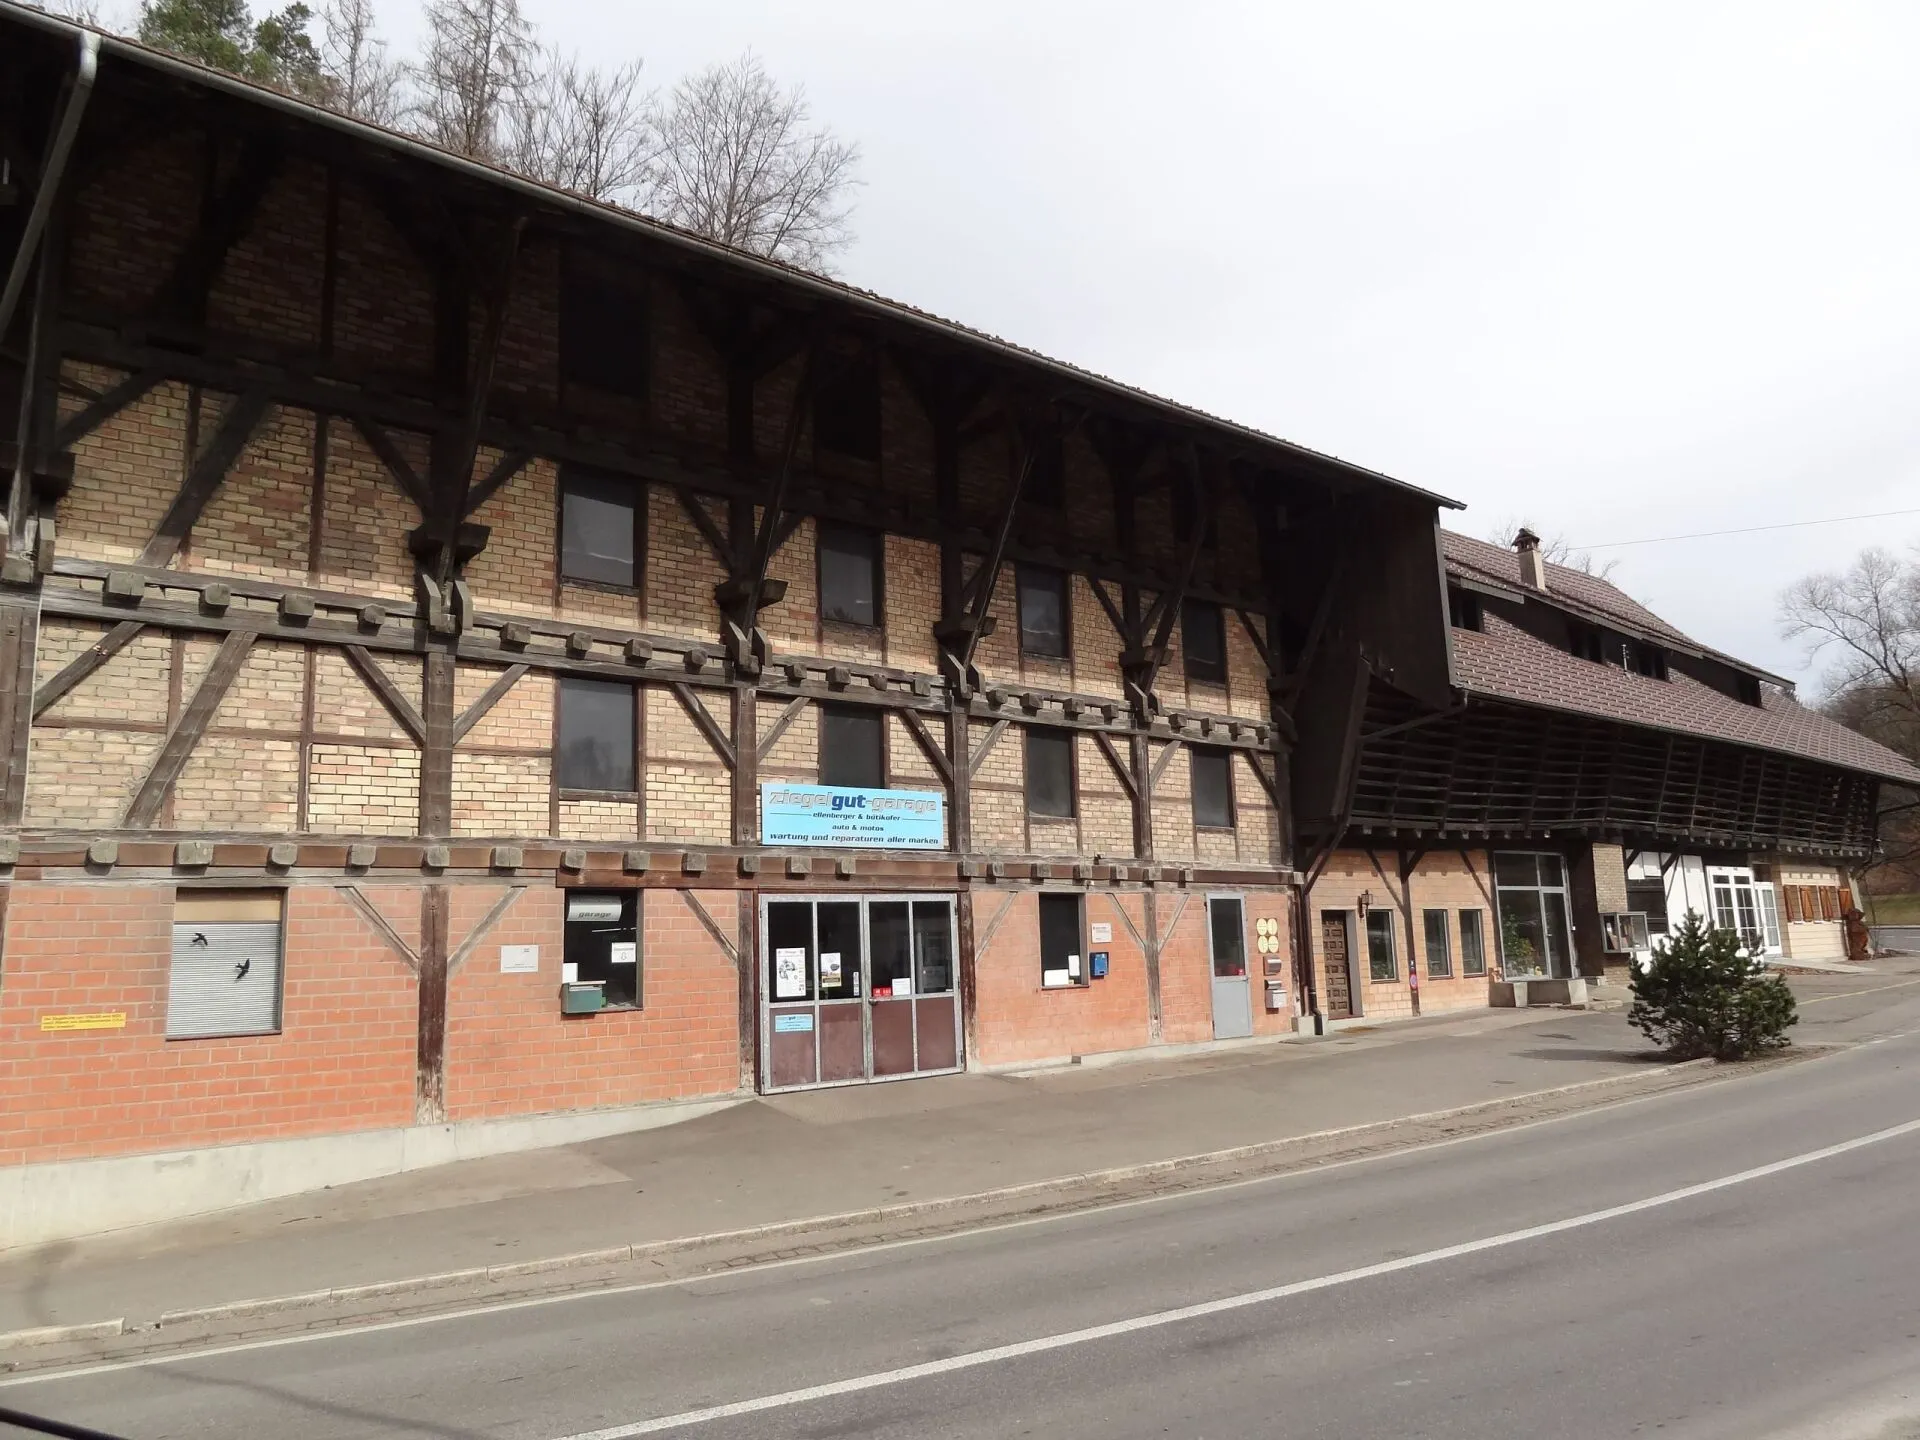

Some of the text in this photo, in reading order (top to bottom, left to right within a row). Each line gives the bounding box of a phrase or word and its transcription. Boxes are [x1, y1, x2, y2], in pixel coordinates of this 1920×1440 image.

[813, 812, 856, 820] ellenberger
[770, 833, 808, 842] wartung
[832, 835, 884, 843] reparaturen
